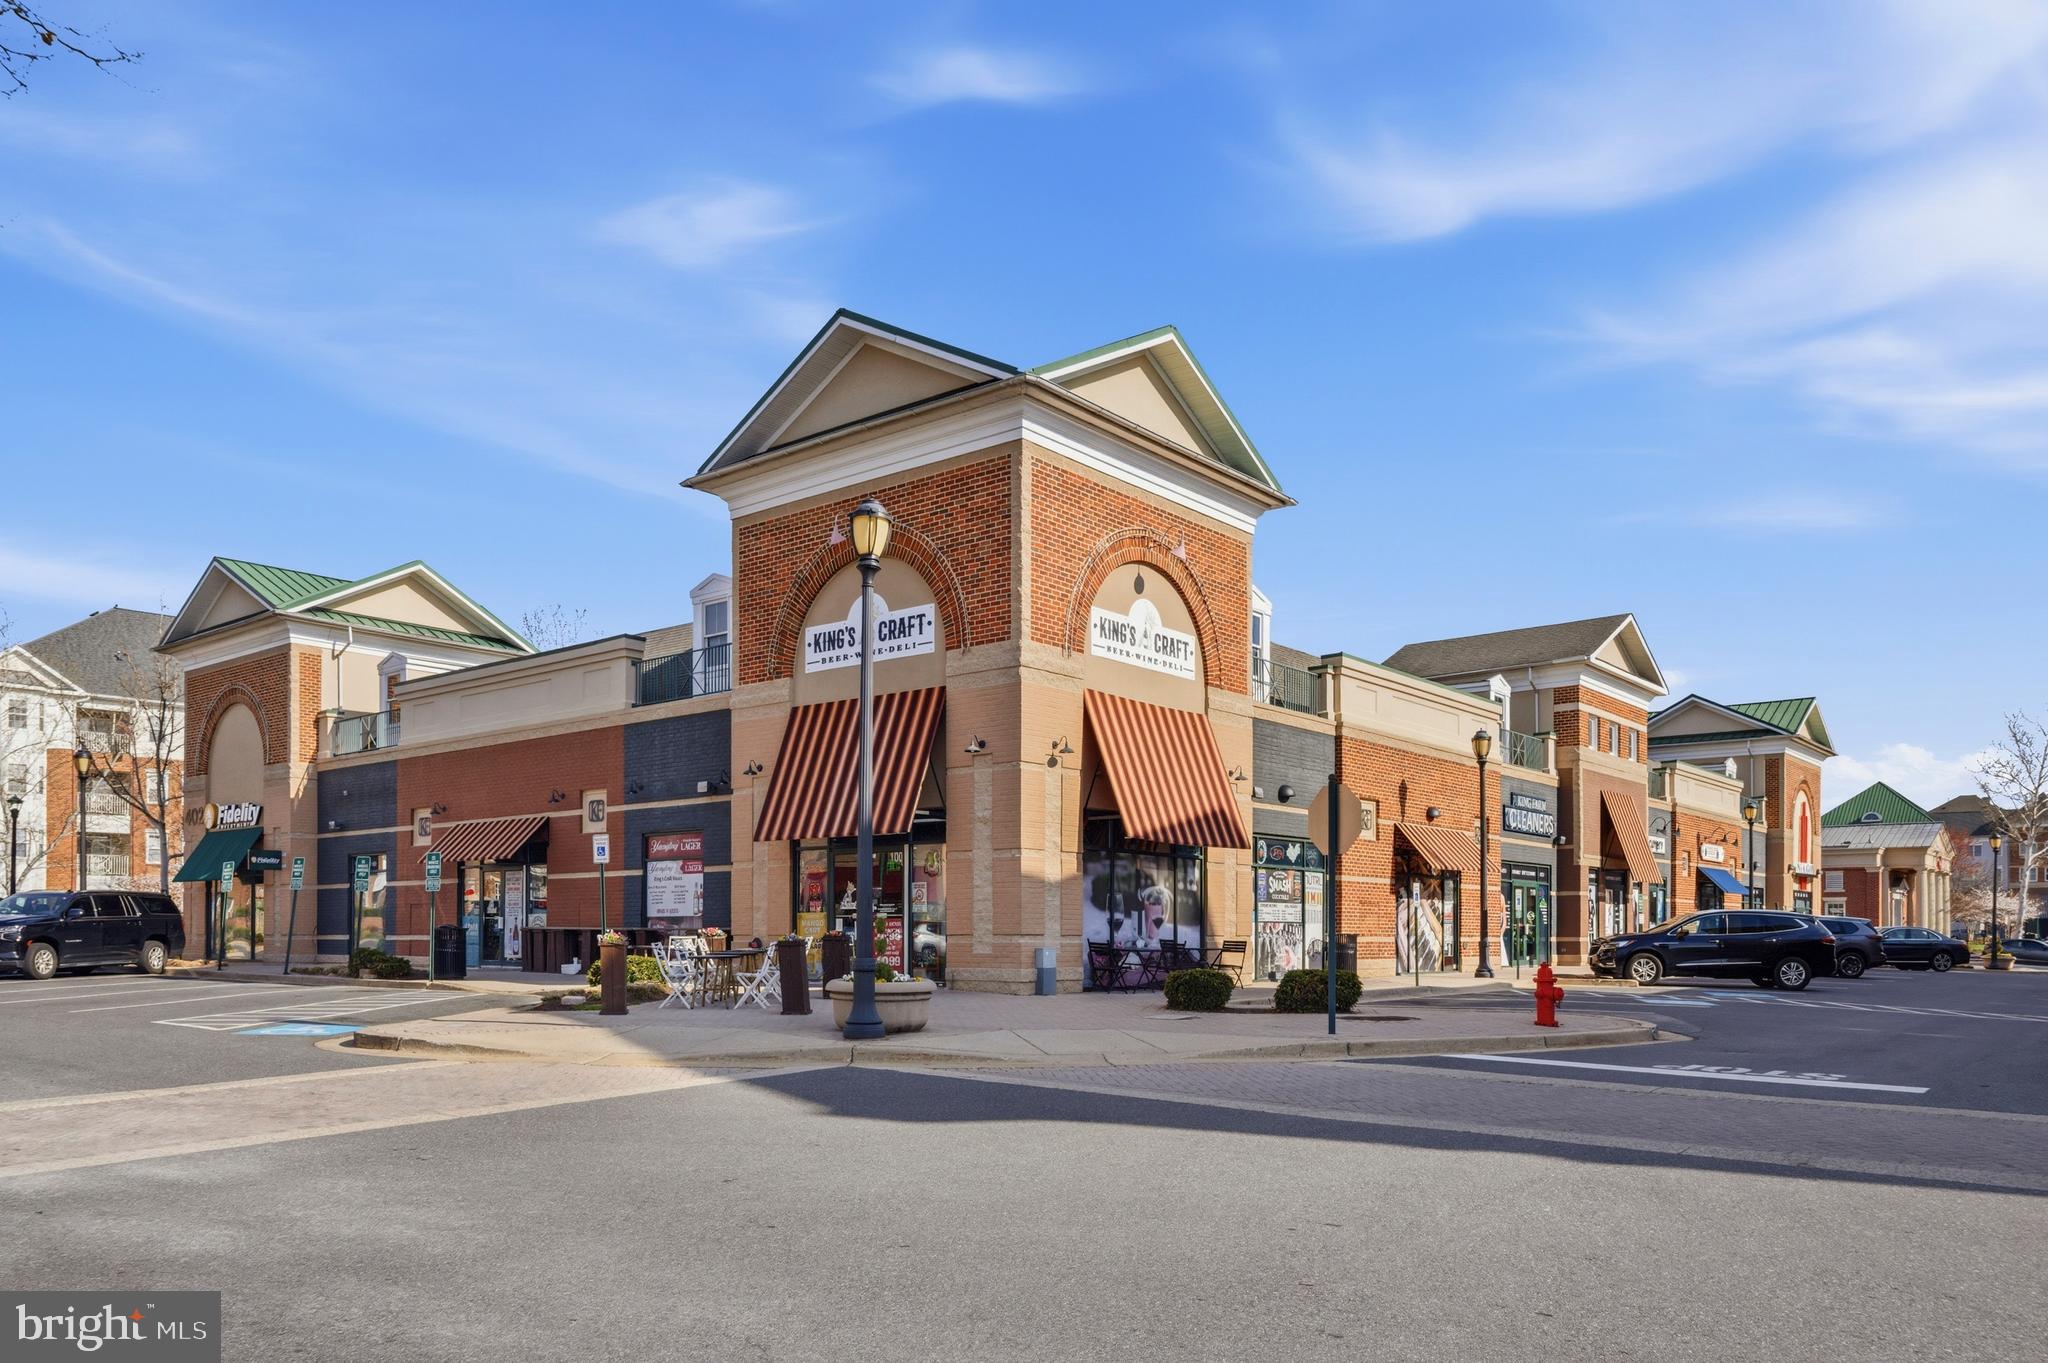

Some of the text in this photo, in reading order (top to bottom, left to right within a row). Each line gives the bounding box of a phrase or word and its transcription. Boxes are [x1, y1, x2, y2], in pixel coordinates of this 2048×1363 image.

[813, 613, 926, 654] KING'S CRAFT
[1099, 616, 1190, 661] KING'S CRAFT
[889, 642, 917, 653] DELI
[218, 801, 262, 827] Fidelity
[1509, 808, 1554, 836] CLEANERS
[680, 841, 702, 851] LAGER
[1268, 875, 1292, 894] SMASH
